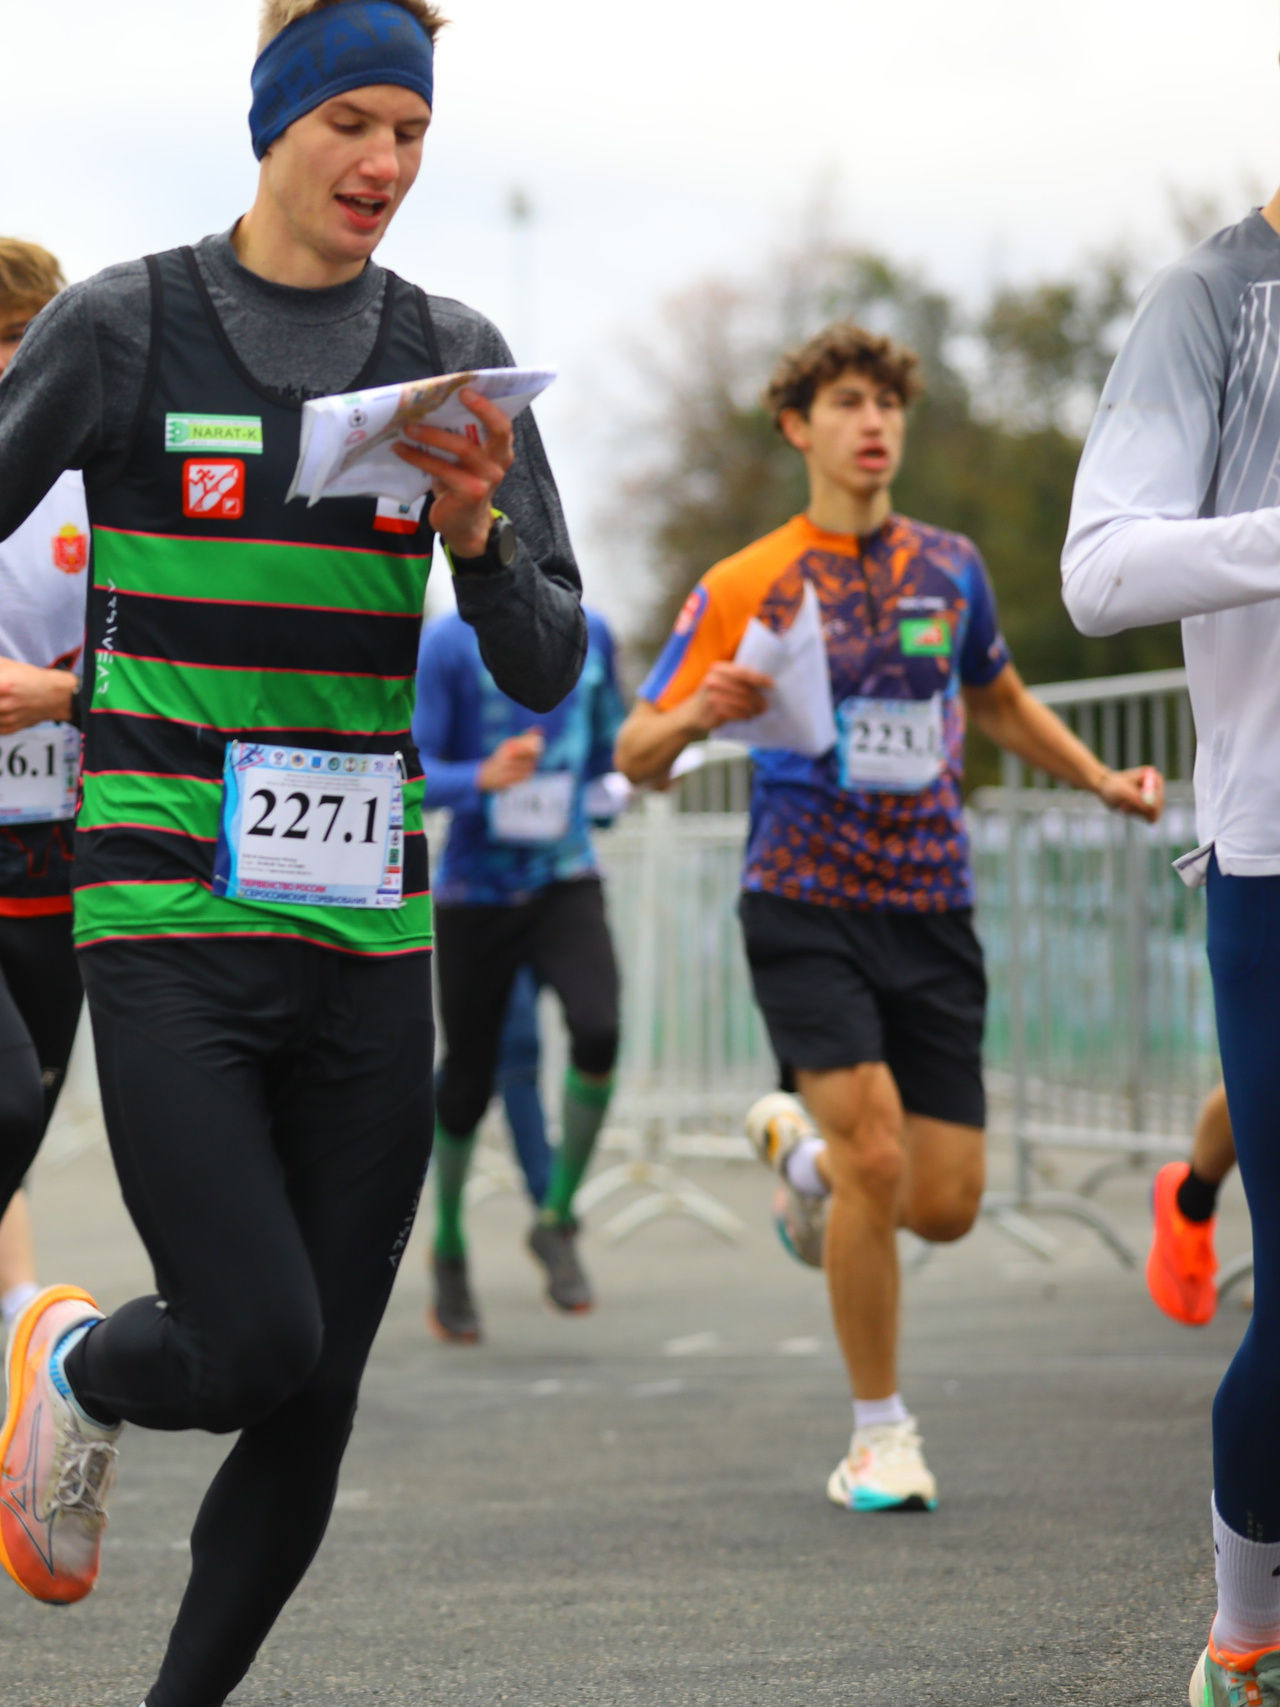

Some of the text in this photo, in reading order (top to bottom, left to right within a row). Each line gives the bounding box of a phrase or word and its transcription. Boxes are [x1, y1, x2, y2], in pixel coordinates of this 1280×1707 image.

[192, 426, 258, 441] NARAT-K
[854, 719, 935, 757] 223.1
[246, 788, 379, 844] 227.1
